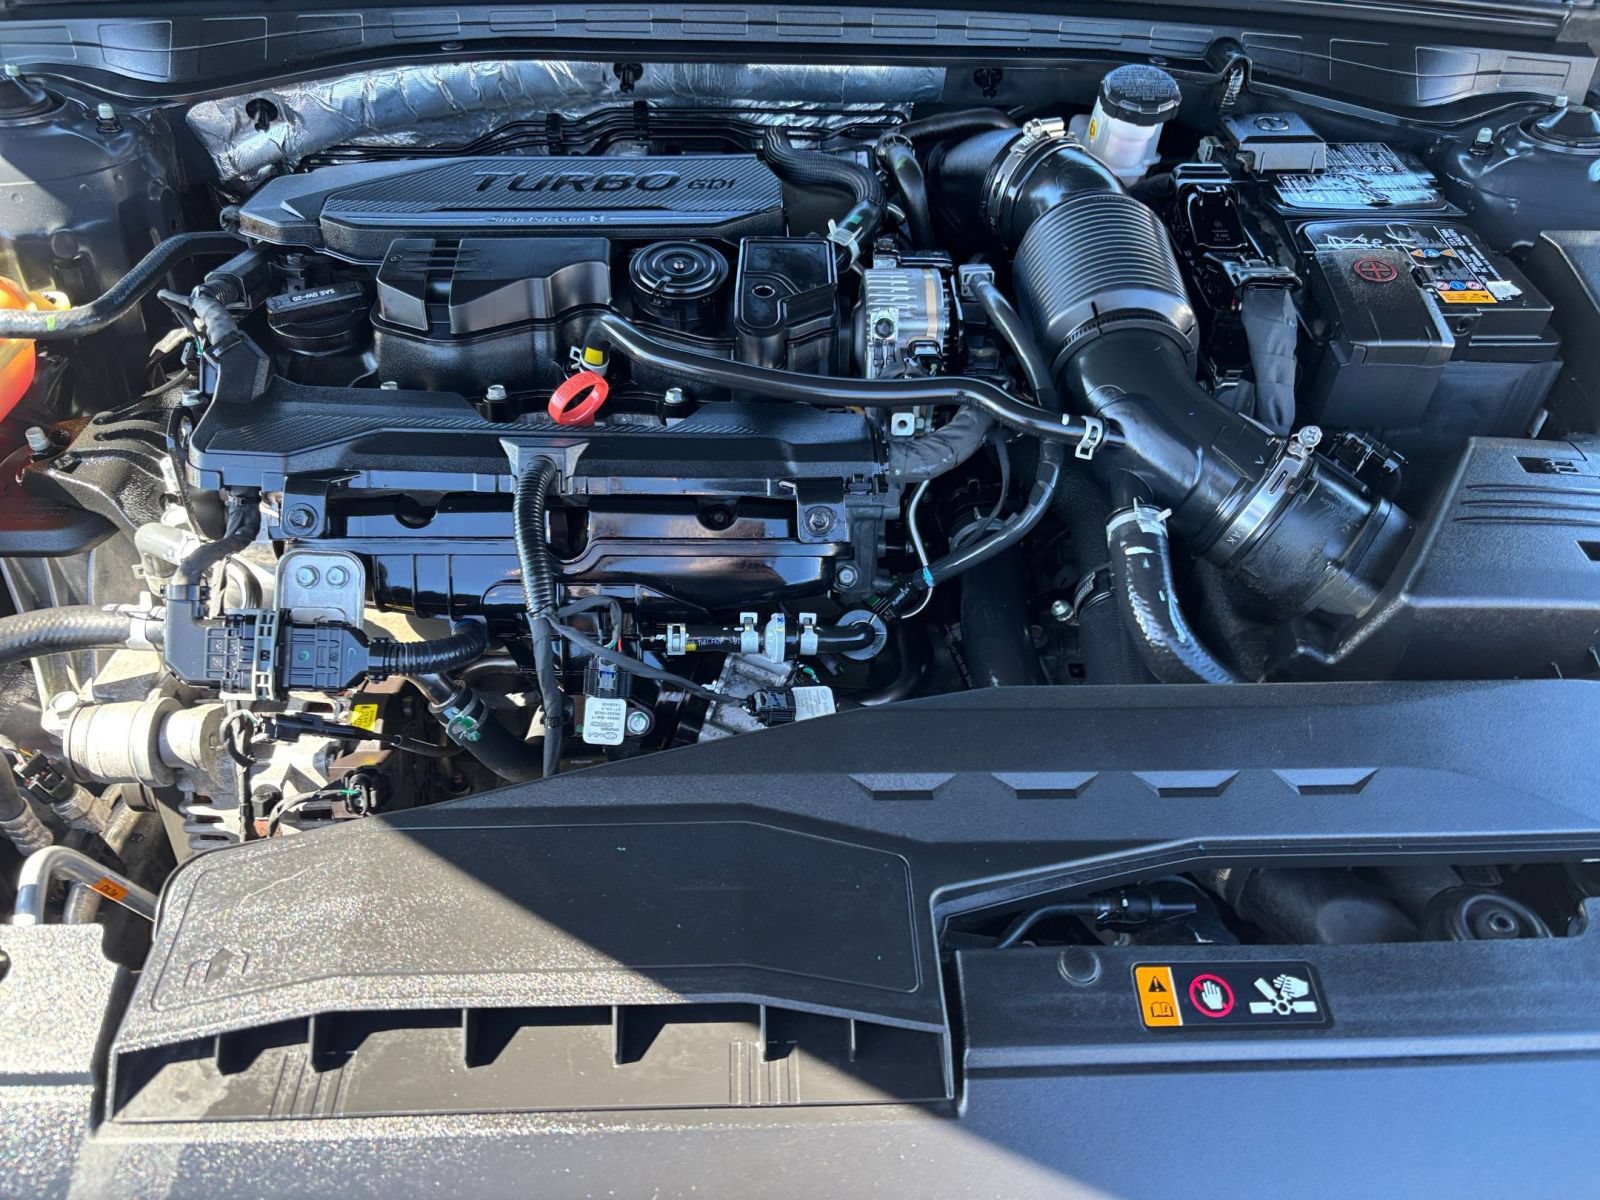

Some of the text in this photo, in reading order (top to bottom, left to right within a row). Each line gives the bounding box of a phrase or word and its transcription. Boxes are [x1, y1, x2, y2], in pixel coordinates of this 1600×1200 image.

[473, 171, 681, 193] TURBO
[292, 288, 336, 302] SAE 0W-20
